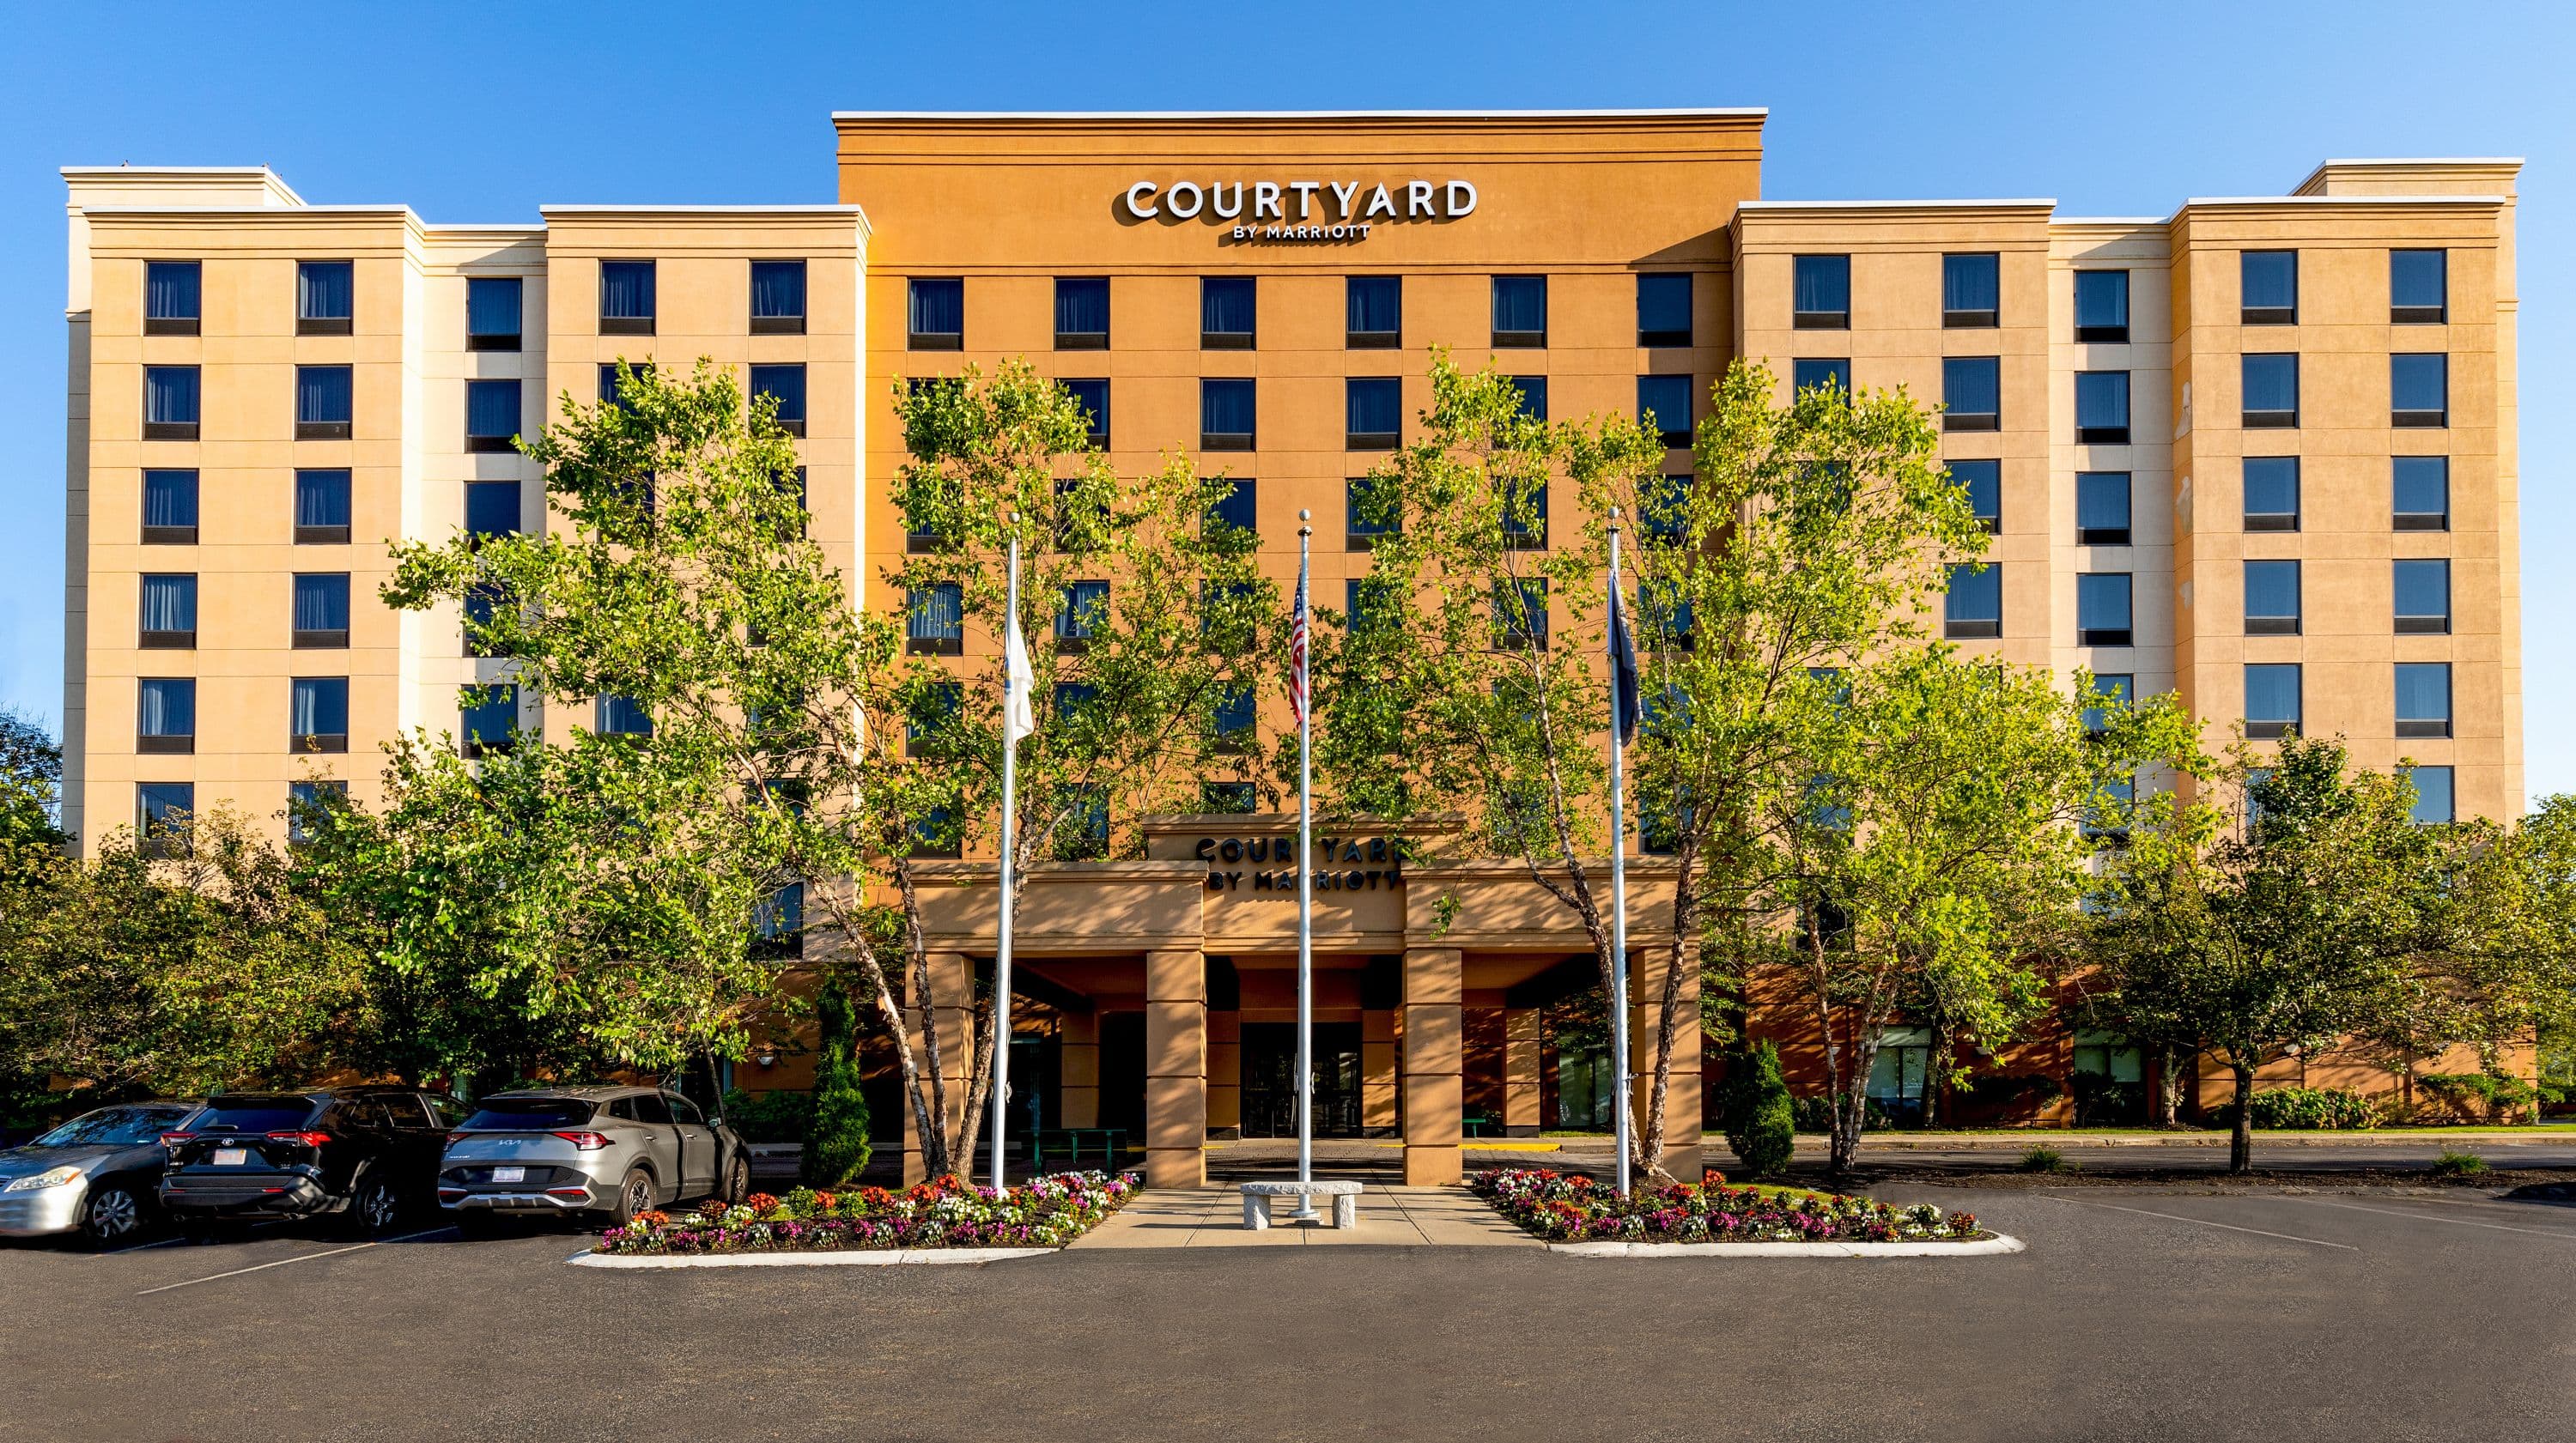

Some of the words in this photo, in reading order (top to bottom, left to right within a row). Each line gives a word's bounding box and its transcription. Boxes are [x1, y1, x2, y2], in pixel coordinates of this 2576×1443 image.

[1127, 180, 1478, 218] COURTYARD
[1233, 225, 1259, 239] BY
[1267, 225, 1370, 239] MARRIOTT
[1195, 837, 1413, 862] COURYAR
[1208, 871, 1242, 890] BY
[1255, 870, 1400, 890] MARIOTT
